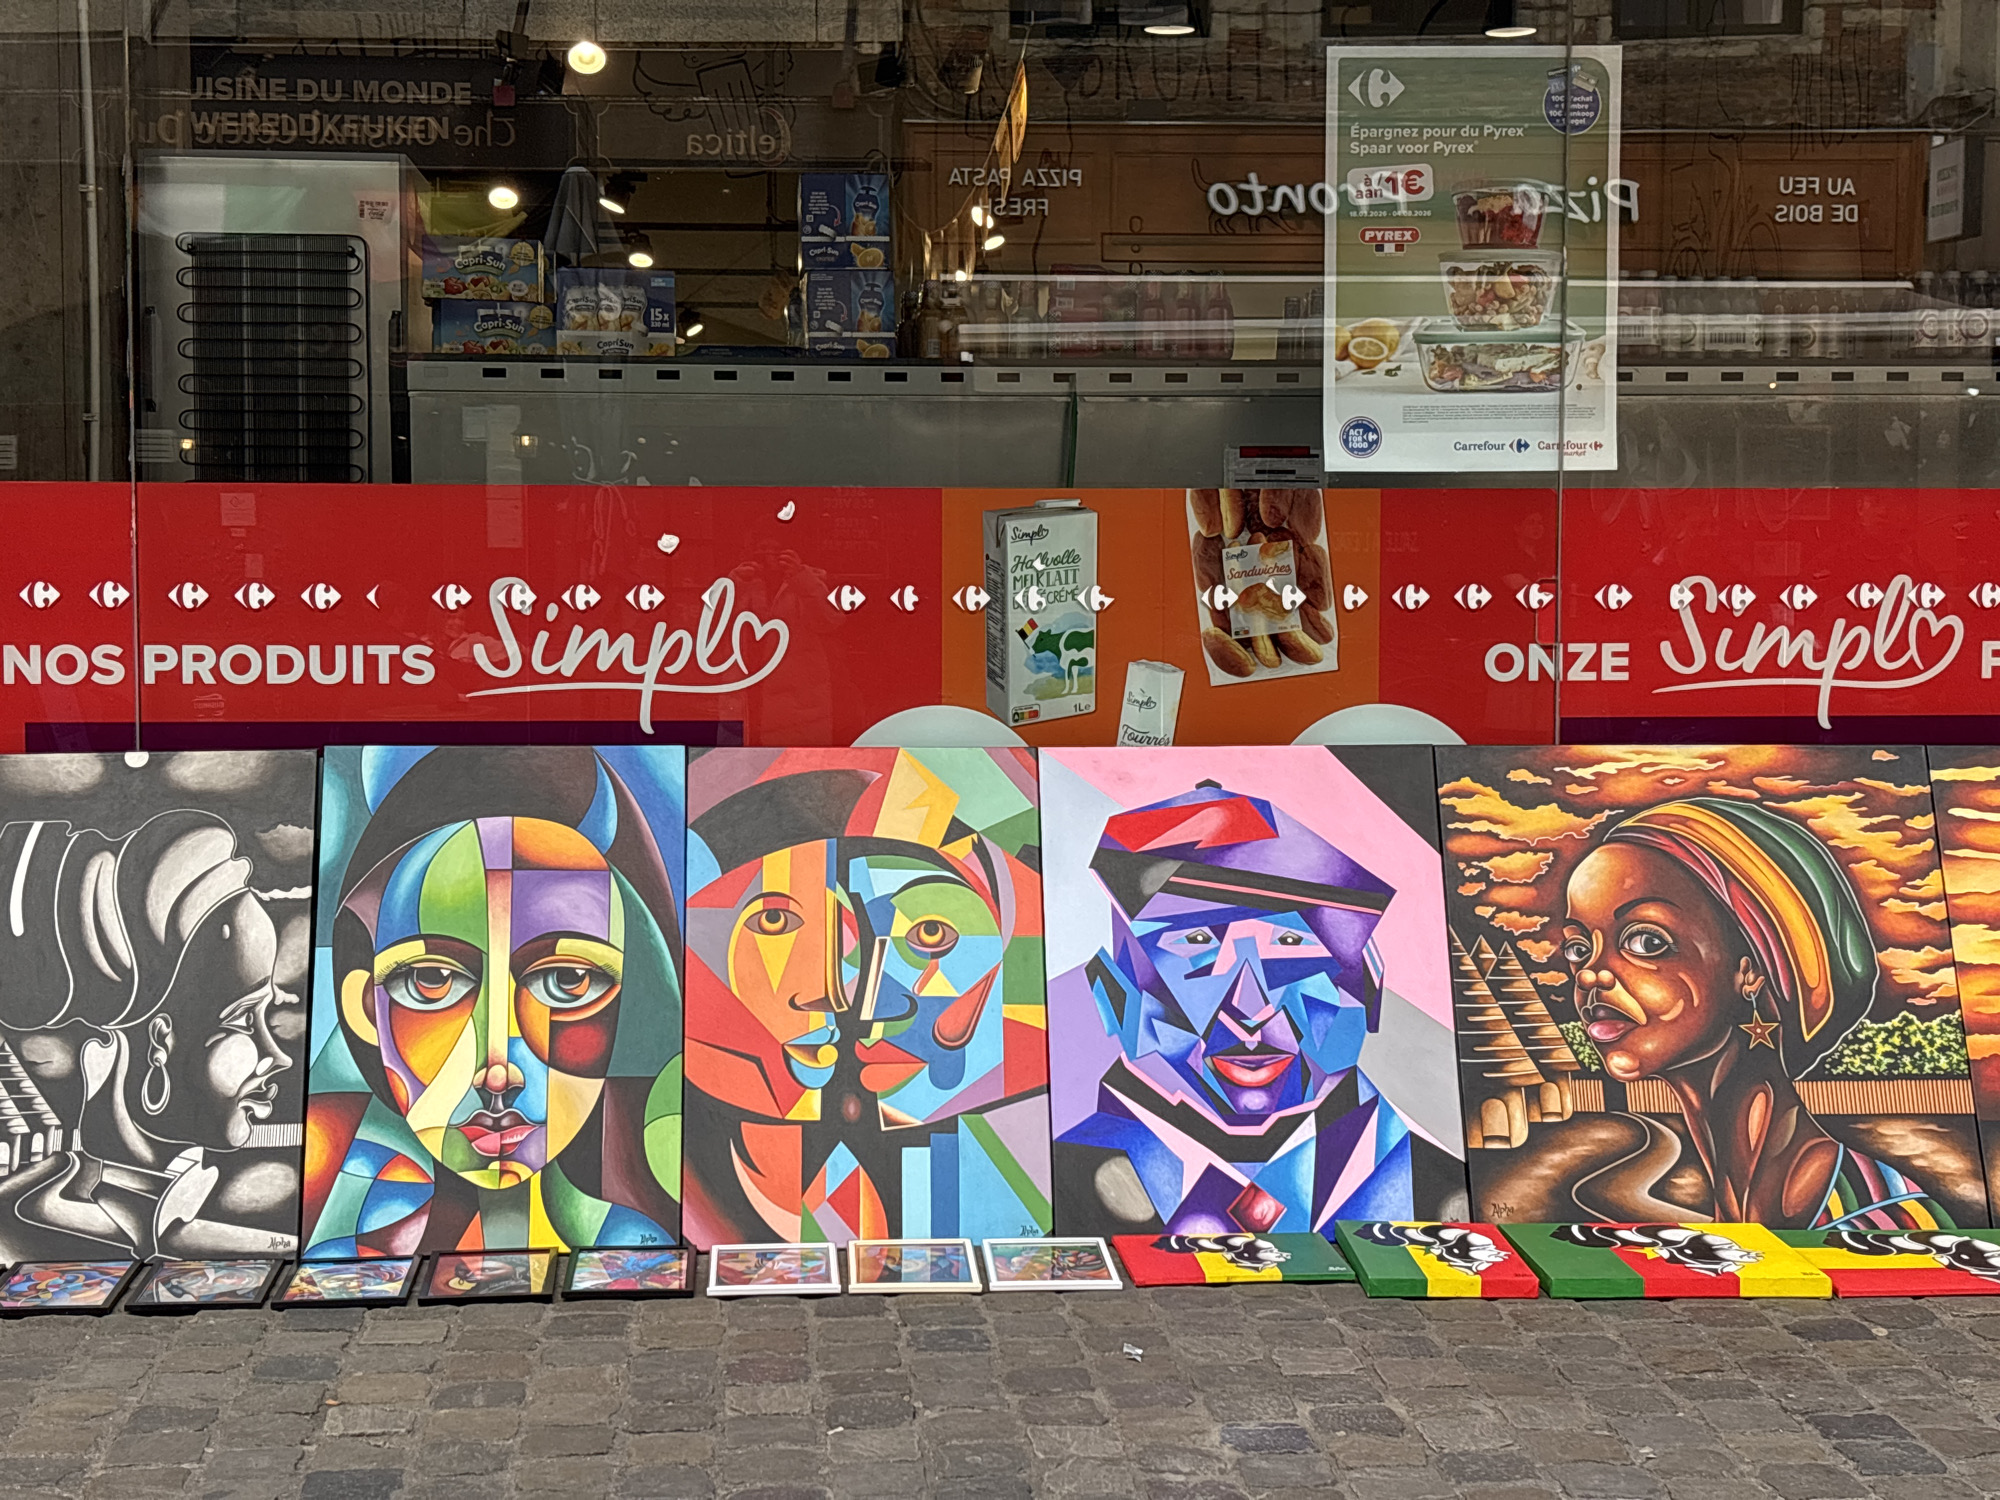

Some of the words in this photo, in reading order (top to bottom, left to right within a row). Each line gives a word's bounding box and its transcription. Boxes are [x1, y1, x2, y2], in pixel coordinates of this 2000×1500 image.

[296, 78, 343, 103] DU
[352, 80, 472, 105] MONDE
[190, 111, 450, 141] WERELDKEUKEN
[1349, 122, 1419, 140] Épargnez
[1423, 126, 1457, 140] pour
[1460, 125, 1479, 138] du
[1349, 142, 1393, 157] Spaar
[1396, 144, 1430, 154] voor
[1384, 169, 1426, 196] 1€
[1355, 188, 1383, 200] aan
[1364, 230, 1414, 241] PYREX
[454, 254, 507, 271] Capri-Sun
[473, 317, 526, 334] Capri-Sun
[1349, 428, 1363, 436] ACT
[1453, 441, 1506, 451] Carrefour
[1537, 440, 1588, 450] Carrfour
[1046, 568, 1080, 588] LAIT
[1226, 562, 1293, 581] Sandwiches
[3, 643, 126, 686] NOS
[144, 643, 436, 686] PRODUITS
[465, 576, 791, 736] Simpl
[1484, 642, 1631, 682] ONZE
[1651, 574, 1965, 730] Simpl
[1122, 724, 1170, 746] Fourrés
[1491, 1202, 1515, 1219] Alpha
